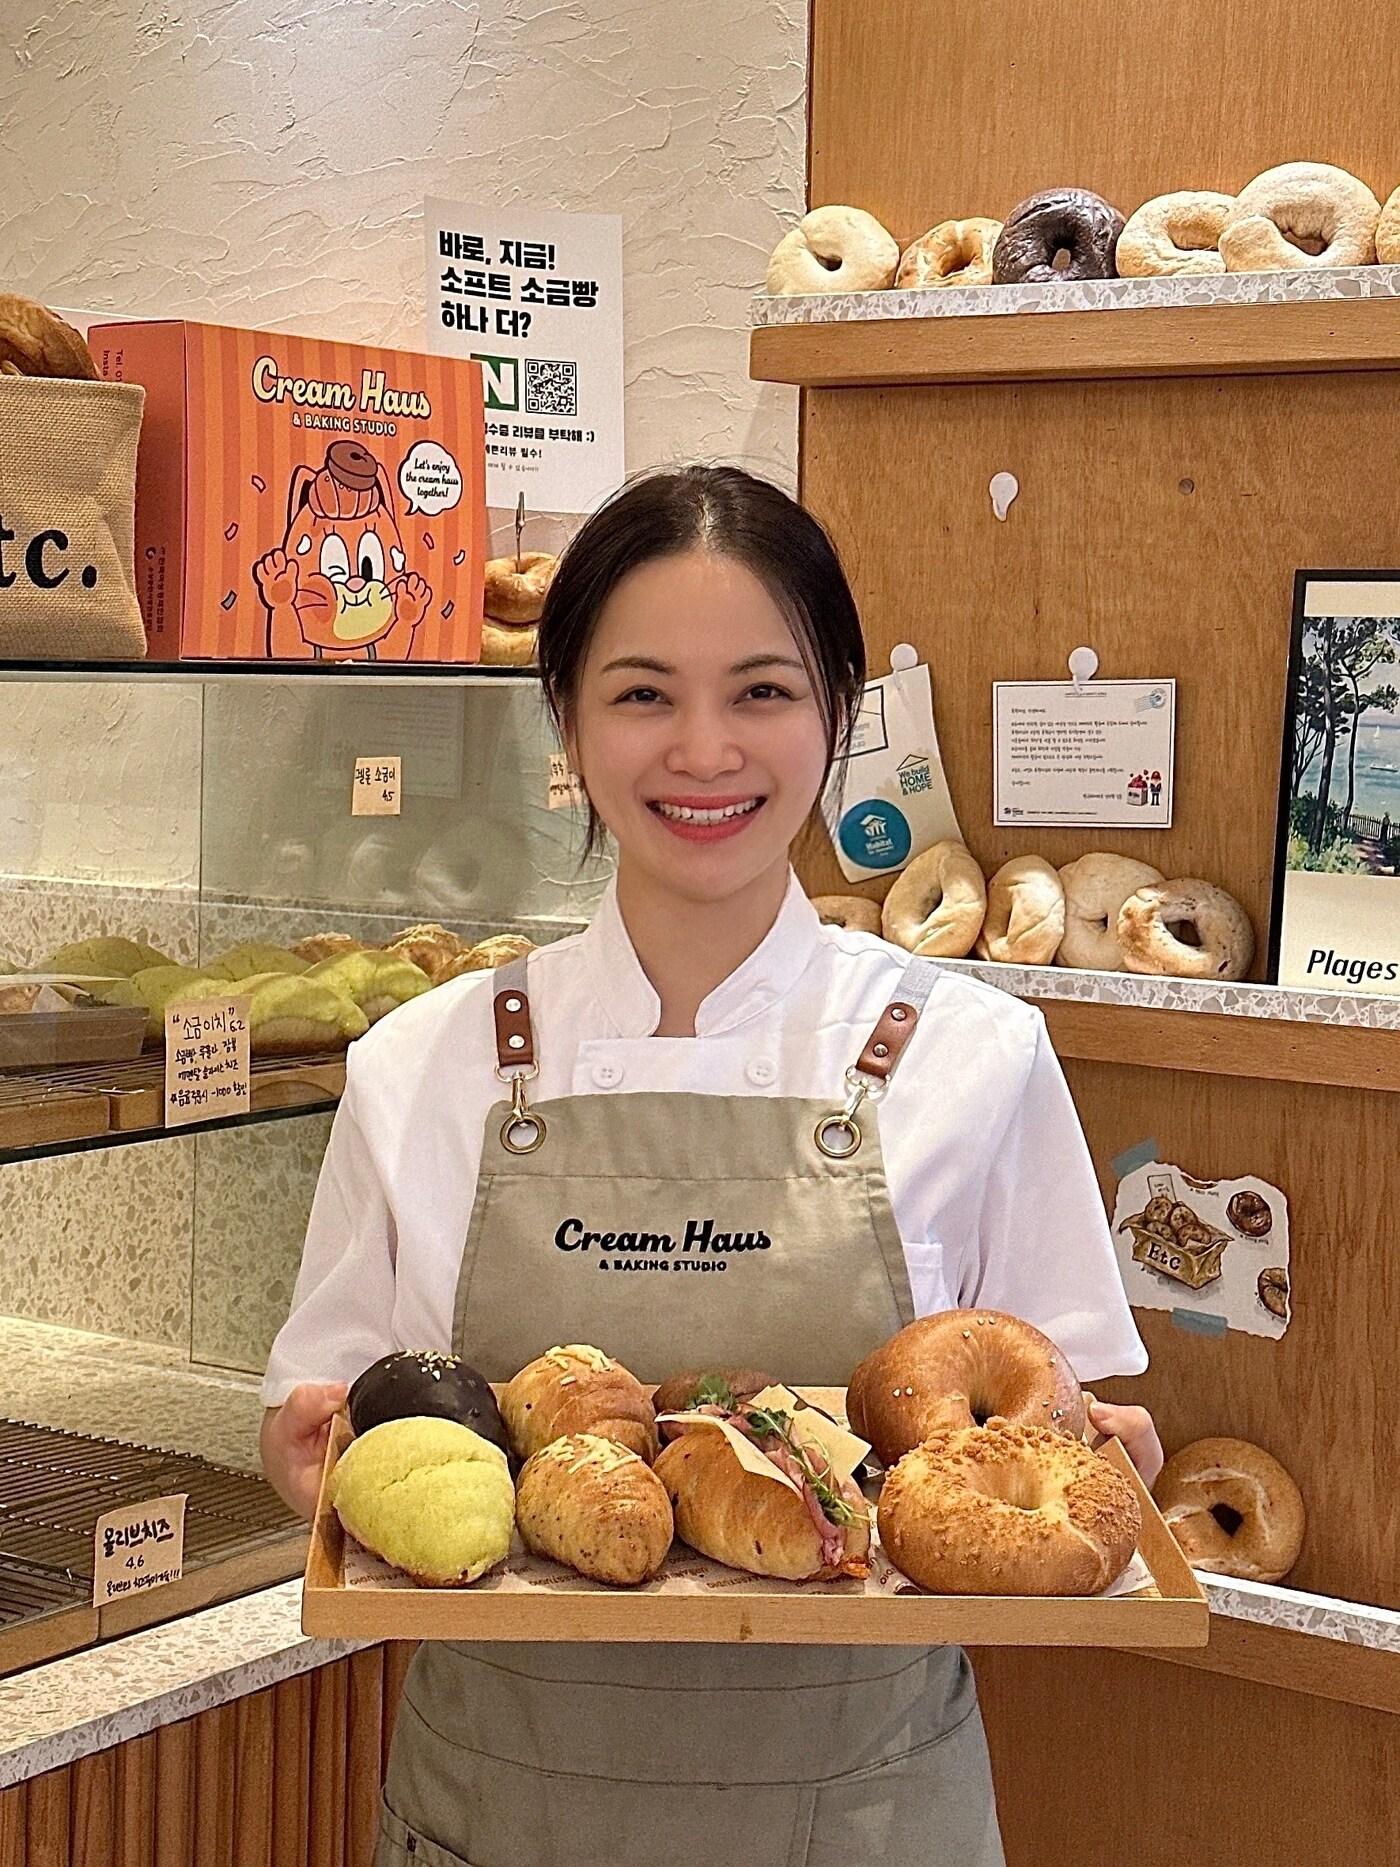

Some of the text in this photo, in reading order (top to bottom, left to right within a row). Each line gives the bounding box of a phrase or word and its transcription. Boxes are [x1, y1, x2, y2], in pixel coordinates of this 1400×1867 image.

[439, 230, 555, 270] 바로, 지금!
[441, 266, 599, 308] 소프트 소금빵
[441, 300, 532, 338] 하나 더?
[252, 356, 431, 420] Cream Haus
[293, 413, 397, 436] & BAKING STUDIO
[484, 422, 509, 437] 수증
[513, 425, 545, 440] 리뷰를
[549, 428, 582, 442] 부탁해
[414, 457, 450, 474] Let's enjoy
[405, 470, 459, 485] the cream haus
[417, 486, 449, 499] together!
[900, 772, 932, 788] HOME
[911, 764, 930, 776] build
[908, 781, 933, 794] HOPE
[1306, 949, 1399, 985] Plages
[554, 1218, 772, 1253] Cream Haus
[599, 1259, 727, 1272] & BAKING STUDIO
[103, 1518, 174, 1558] 올리브치즈
[125, 1554, 145, 1570] 4.6
